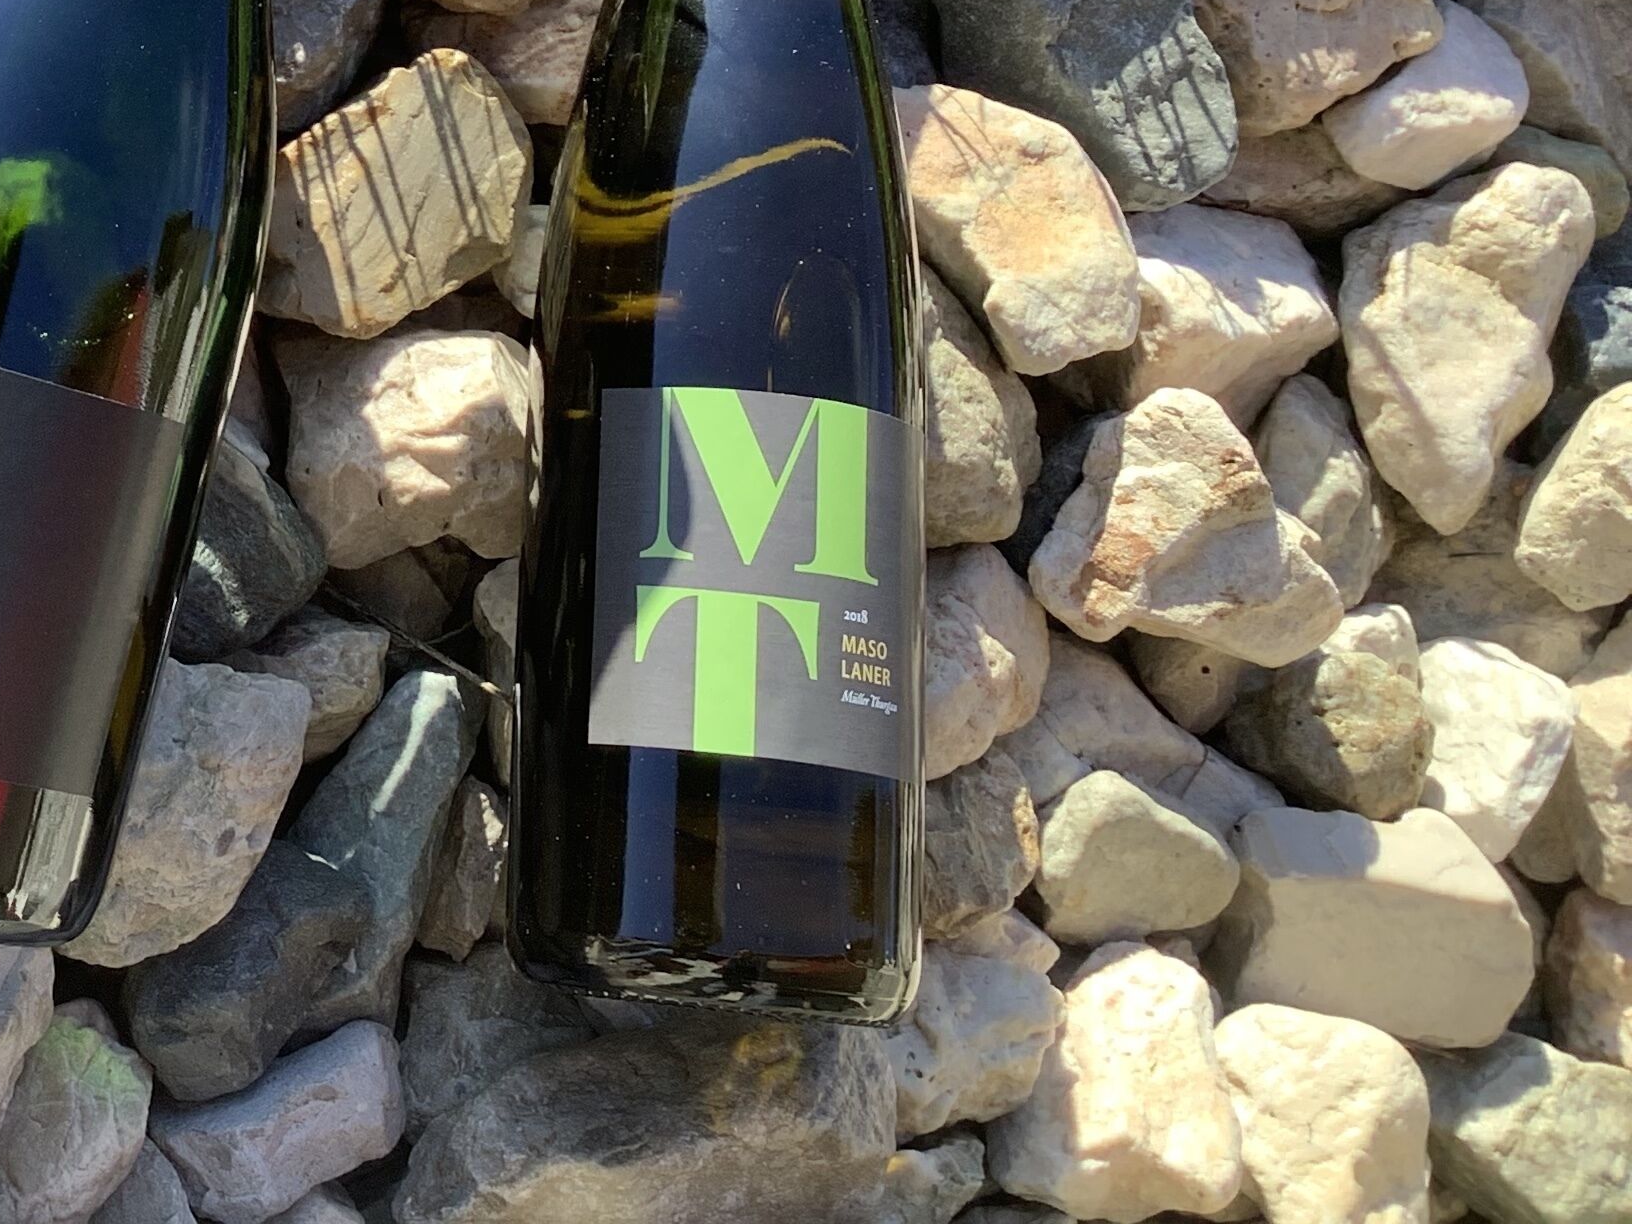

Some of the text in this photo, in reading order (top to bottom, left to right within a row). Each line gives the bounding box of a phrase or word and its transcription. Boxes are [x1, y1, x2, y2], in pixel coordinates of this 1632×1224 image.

[639, 386, 879, 586] M
[843, 609, 869, 624] 2018
[841, 634, 888, 661] MASO
[634, 585, 821, 757] T
[841, 659, 891, 687] LANER
